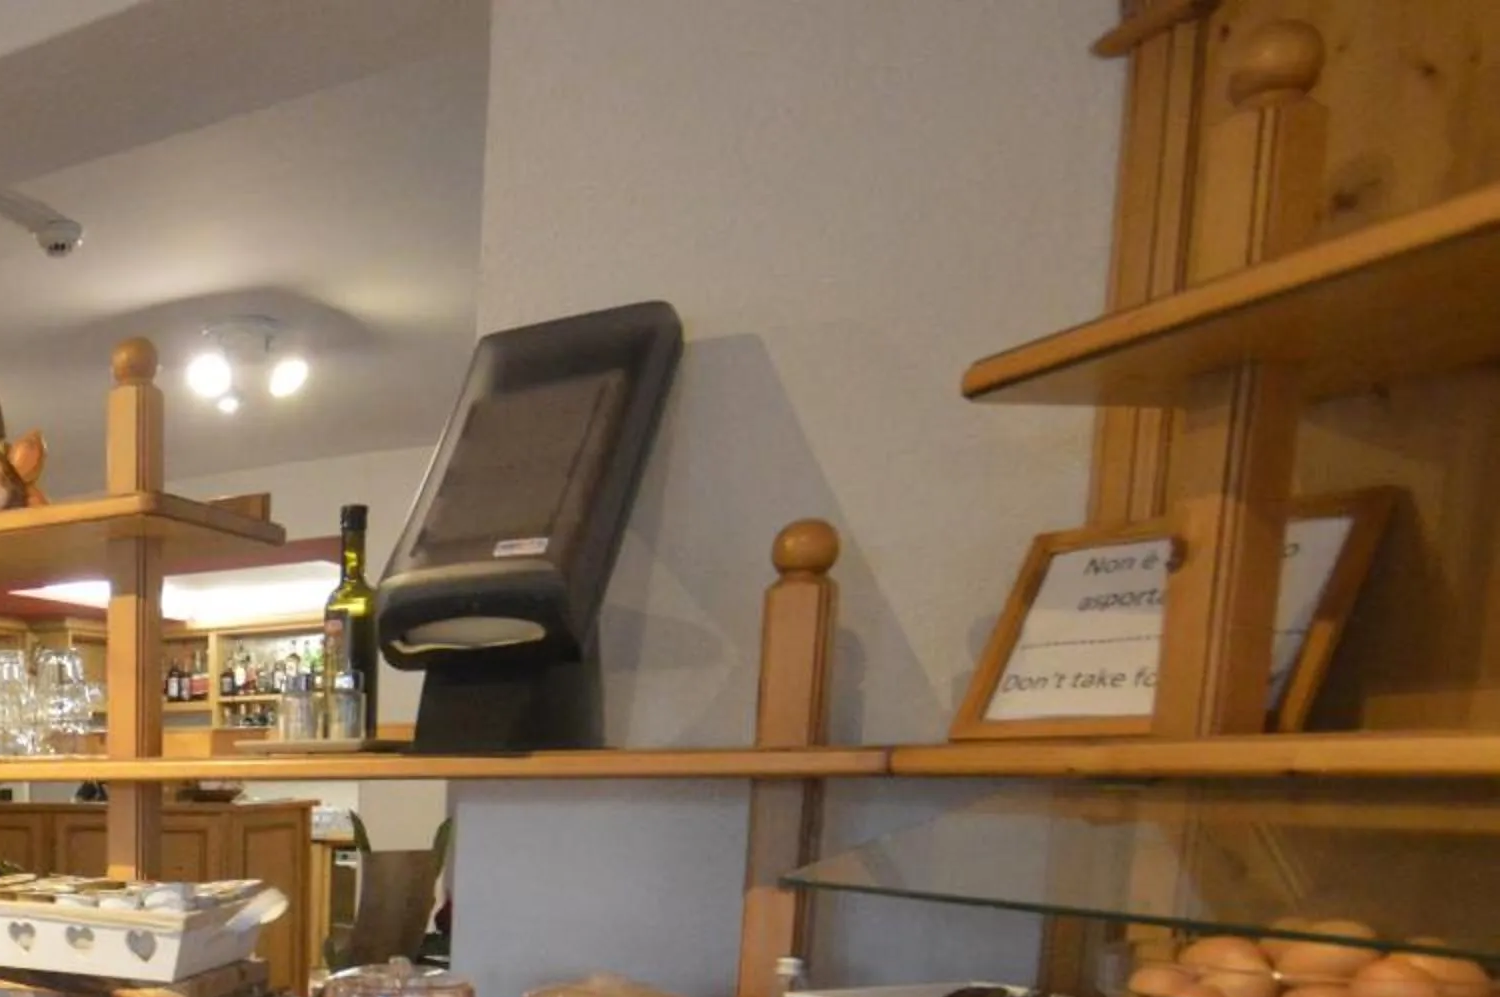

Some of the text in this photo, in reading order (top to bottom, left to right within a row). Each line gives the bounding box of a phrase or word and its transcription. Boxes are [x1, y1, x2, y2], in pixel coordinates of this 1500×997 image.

[1084, 556, 1137, 576] Non
[1002, 671, 1066, 692] Don't
[1071, 668, 1127, 689] take
